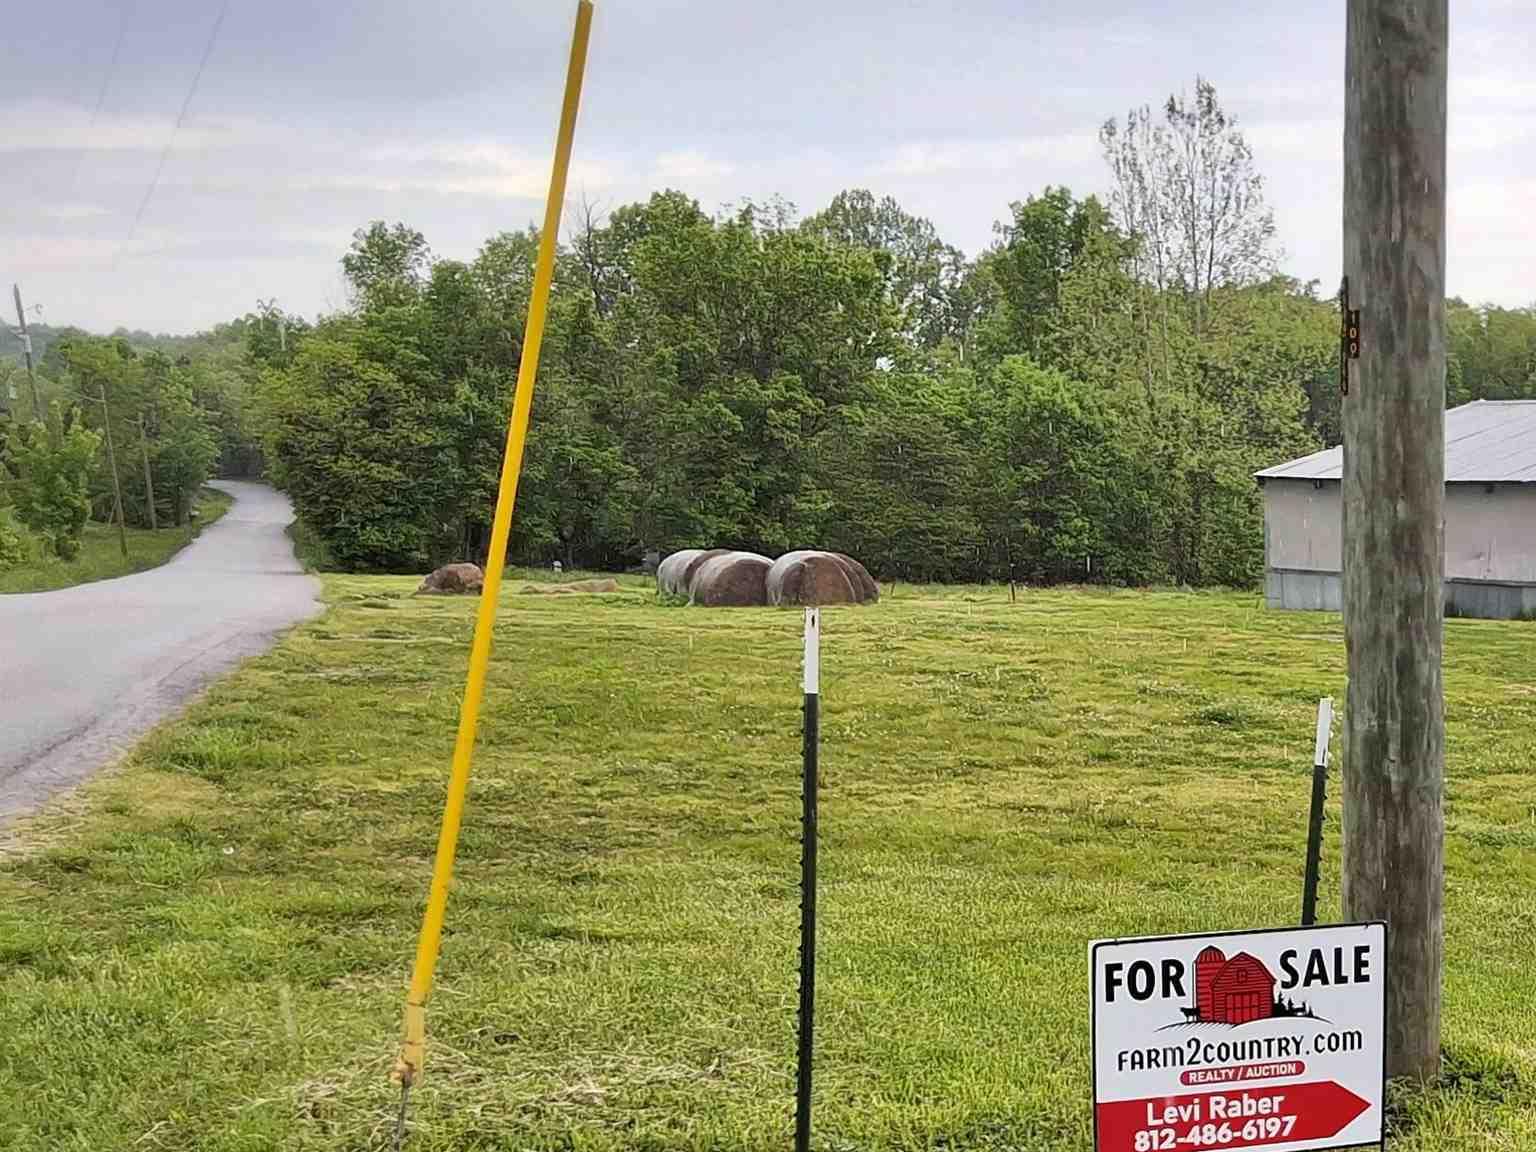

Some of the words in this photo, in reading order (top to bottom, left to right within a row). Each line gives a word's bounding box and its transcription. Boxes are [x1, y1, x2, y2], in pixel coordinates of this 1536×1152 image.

[1105, 959, 1186, 1002] FOR
[1279, 945, 1370, 989] SALE
[1188, 1069, 1234, 1083] REALTY
[1246, 1062, 1296, 1077] AUCTION
[1147, 1099, 1200, 1126] Levi
[1209, 1093, 1285, 1120] Raber
[1134, 1115, 1297, 1152] 812-486-6197
